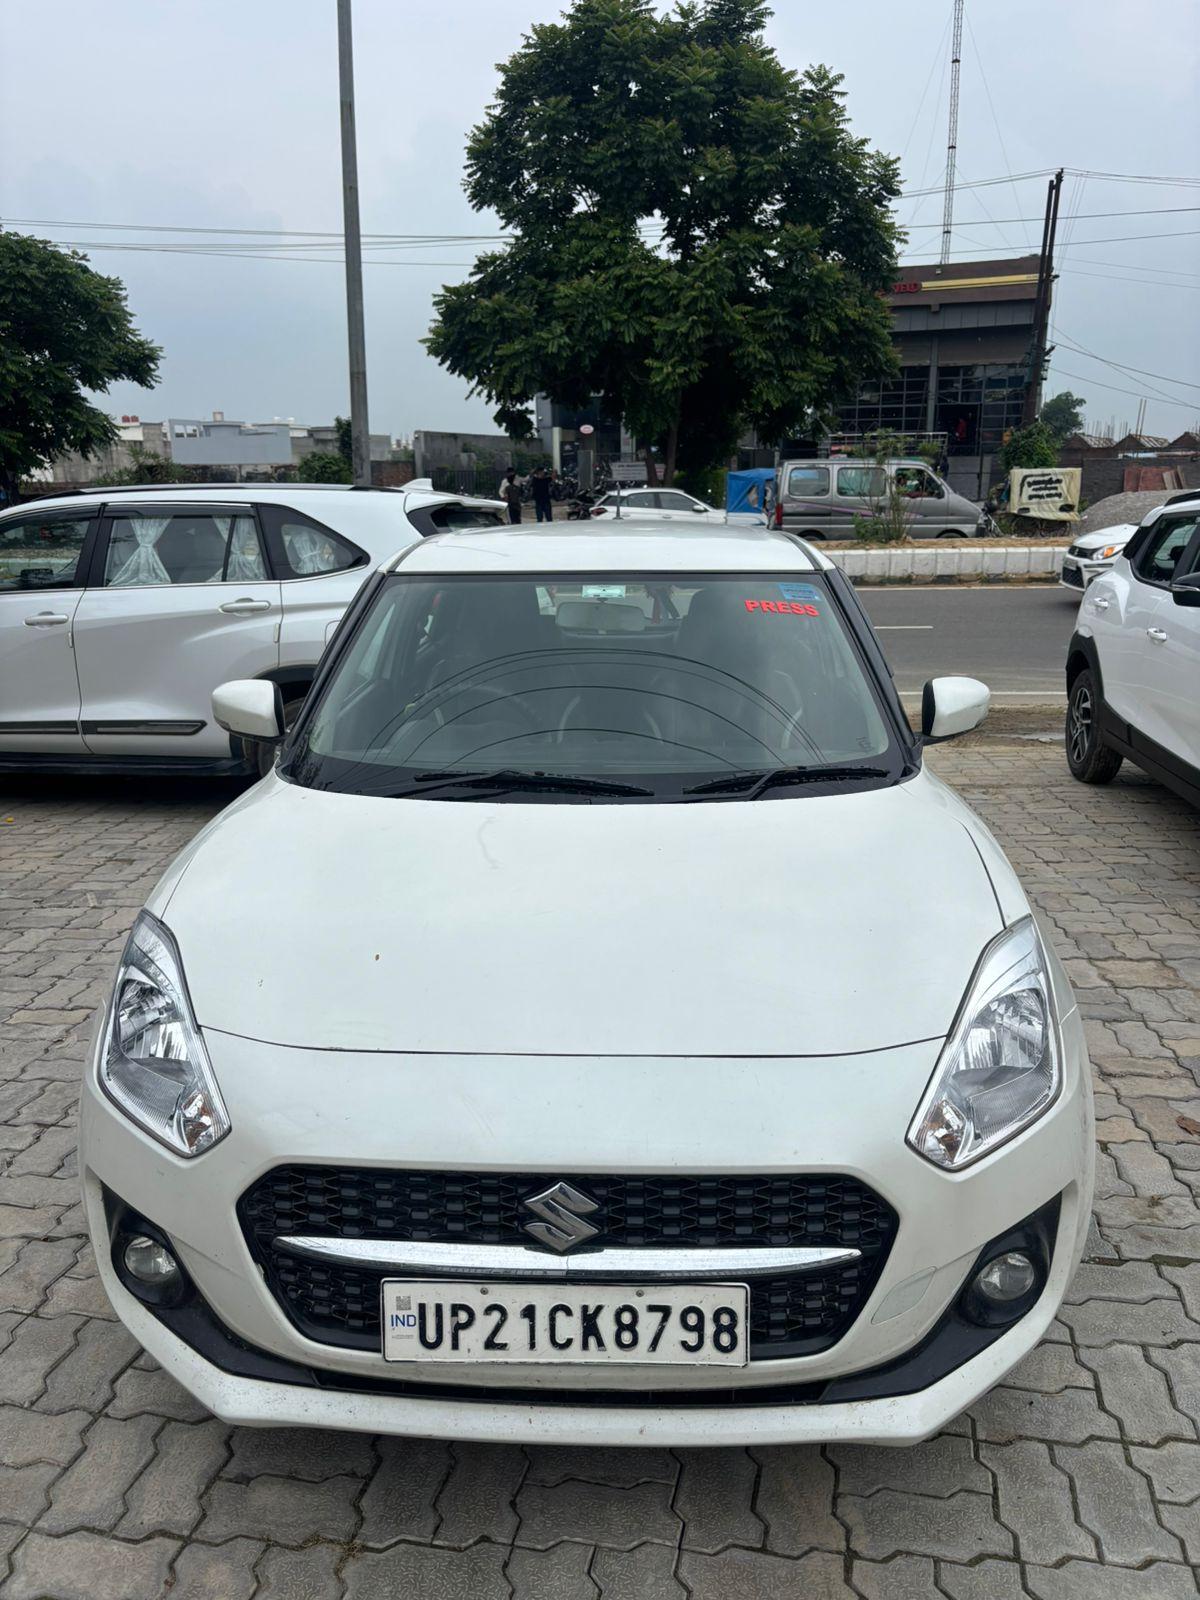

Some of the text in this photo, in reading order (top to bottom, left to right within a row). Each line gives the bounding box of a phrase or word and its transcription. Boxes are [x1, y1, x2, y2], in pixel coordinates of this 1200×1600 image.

[744, 600, 820, 617] PRESS
[391, 1314, 417, 1327] IND
[418, 1303, 739, 1354] UP21CK8798
